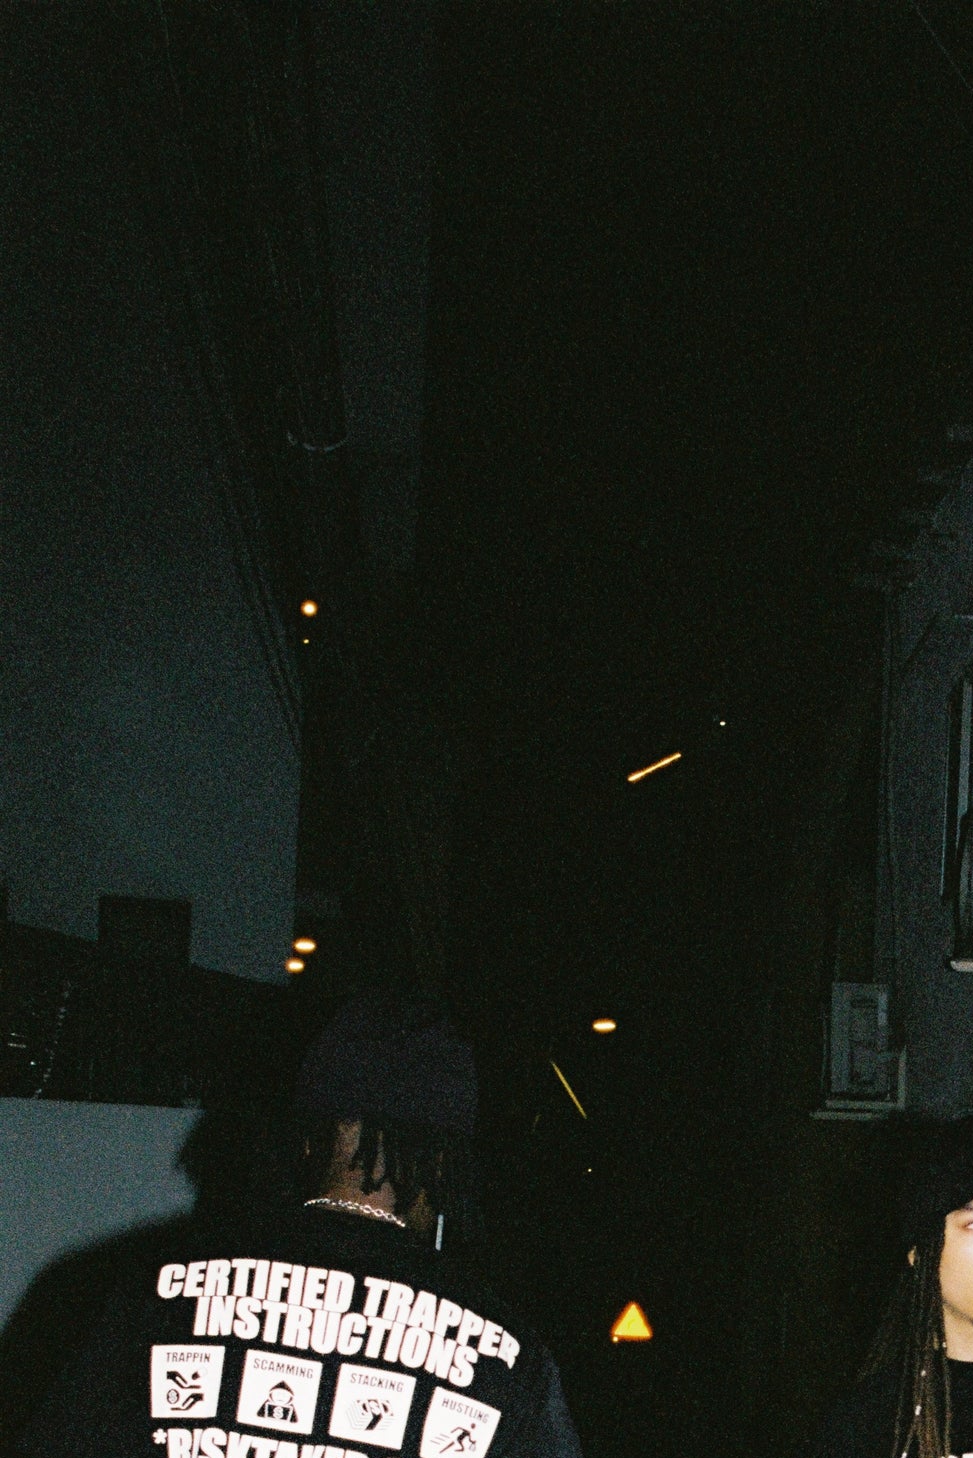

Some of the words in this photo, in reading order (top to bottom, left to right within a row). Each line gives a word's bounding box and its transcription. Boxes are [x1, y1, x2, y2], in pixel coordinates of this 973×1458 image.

[157, 1258, 356, 1313] CERTIFIED
[363, 1276, 520, 1369] TRAPPER
[193, 1295, 479, 1388] INSTRUCTIONS
[166, 1352, 211, 1363] TRAPPIN
[253, 1358, 314, 1379] SCAMMING
[350, 1373, 404, 1393] STACKING
[441, 1397, 490, 1424] HUSTLING
